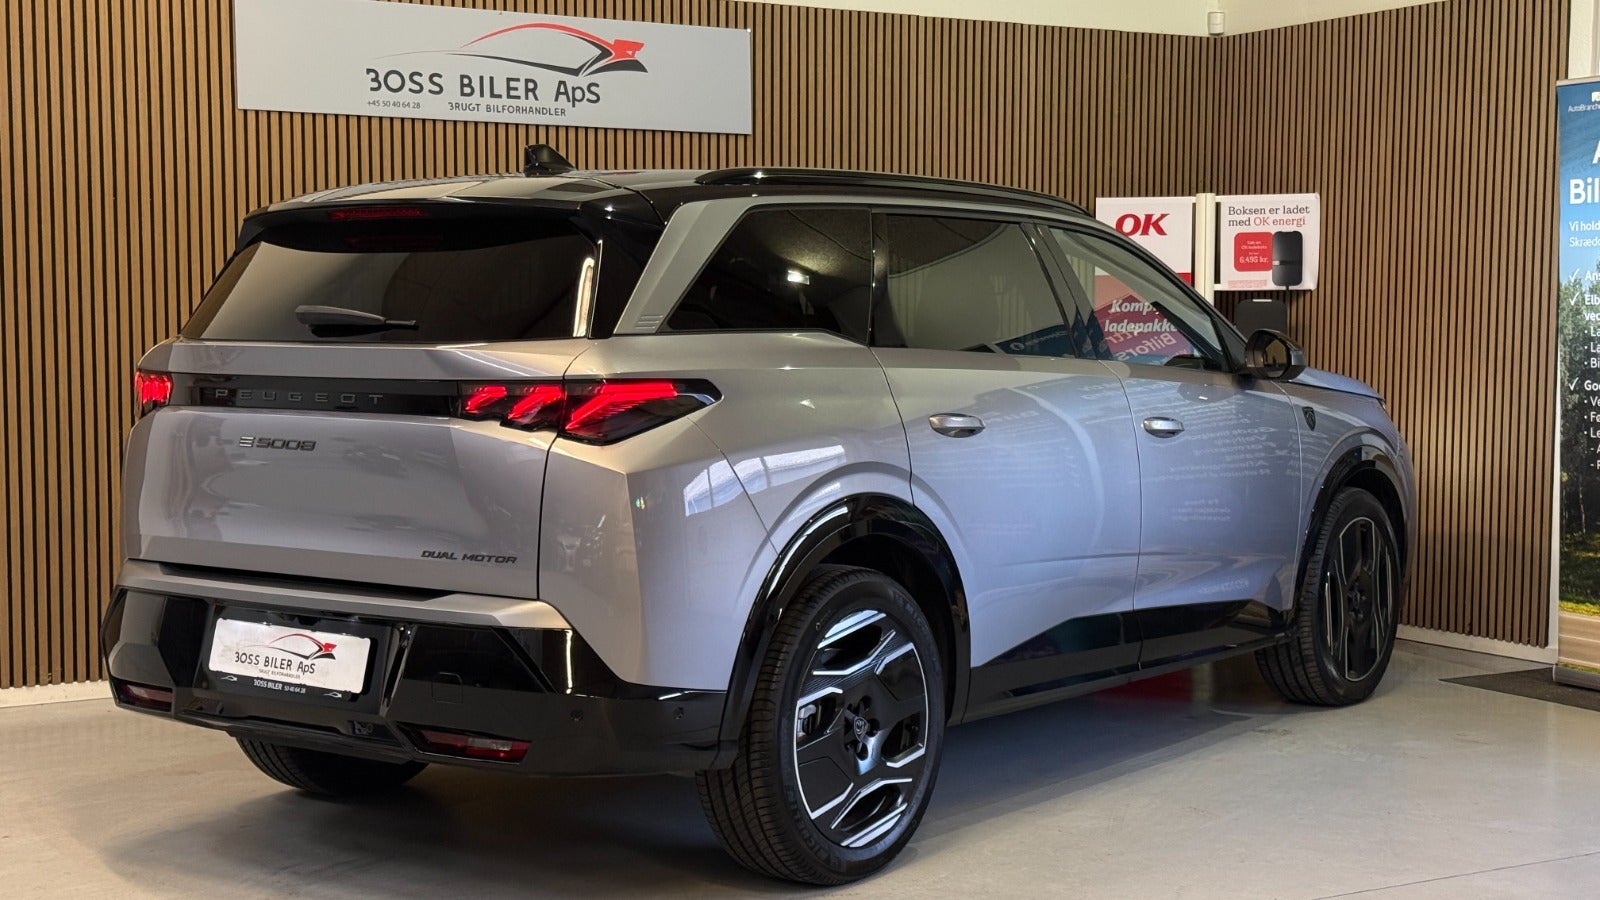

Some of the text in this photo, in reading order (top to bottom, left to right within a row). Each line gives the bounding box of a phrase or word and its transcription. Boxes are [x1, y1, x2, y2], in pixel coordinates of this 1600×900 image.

[459, 74, 539, 101] BILER
[554, 80, 601, 108] ApS
[486, 104, 566, 117] BILFORHANDLER
[1228, 206, 1266, 215] Boksen
[1283, 205, 1310, 214] ladet
[1115, 213, 1170, 236] OK
[1228, 216, 1306, 228] med OK energi
[1569, 221, 1579, 232] Vi
[216, 388, 383, 405] PEUGEOT
[421, 550, 518, 564] DUAL MOTOR
[264, 656, 292, 670] BILER
[296, 661, 316, 675] ApS
